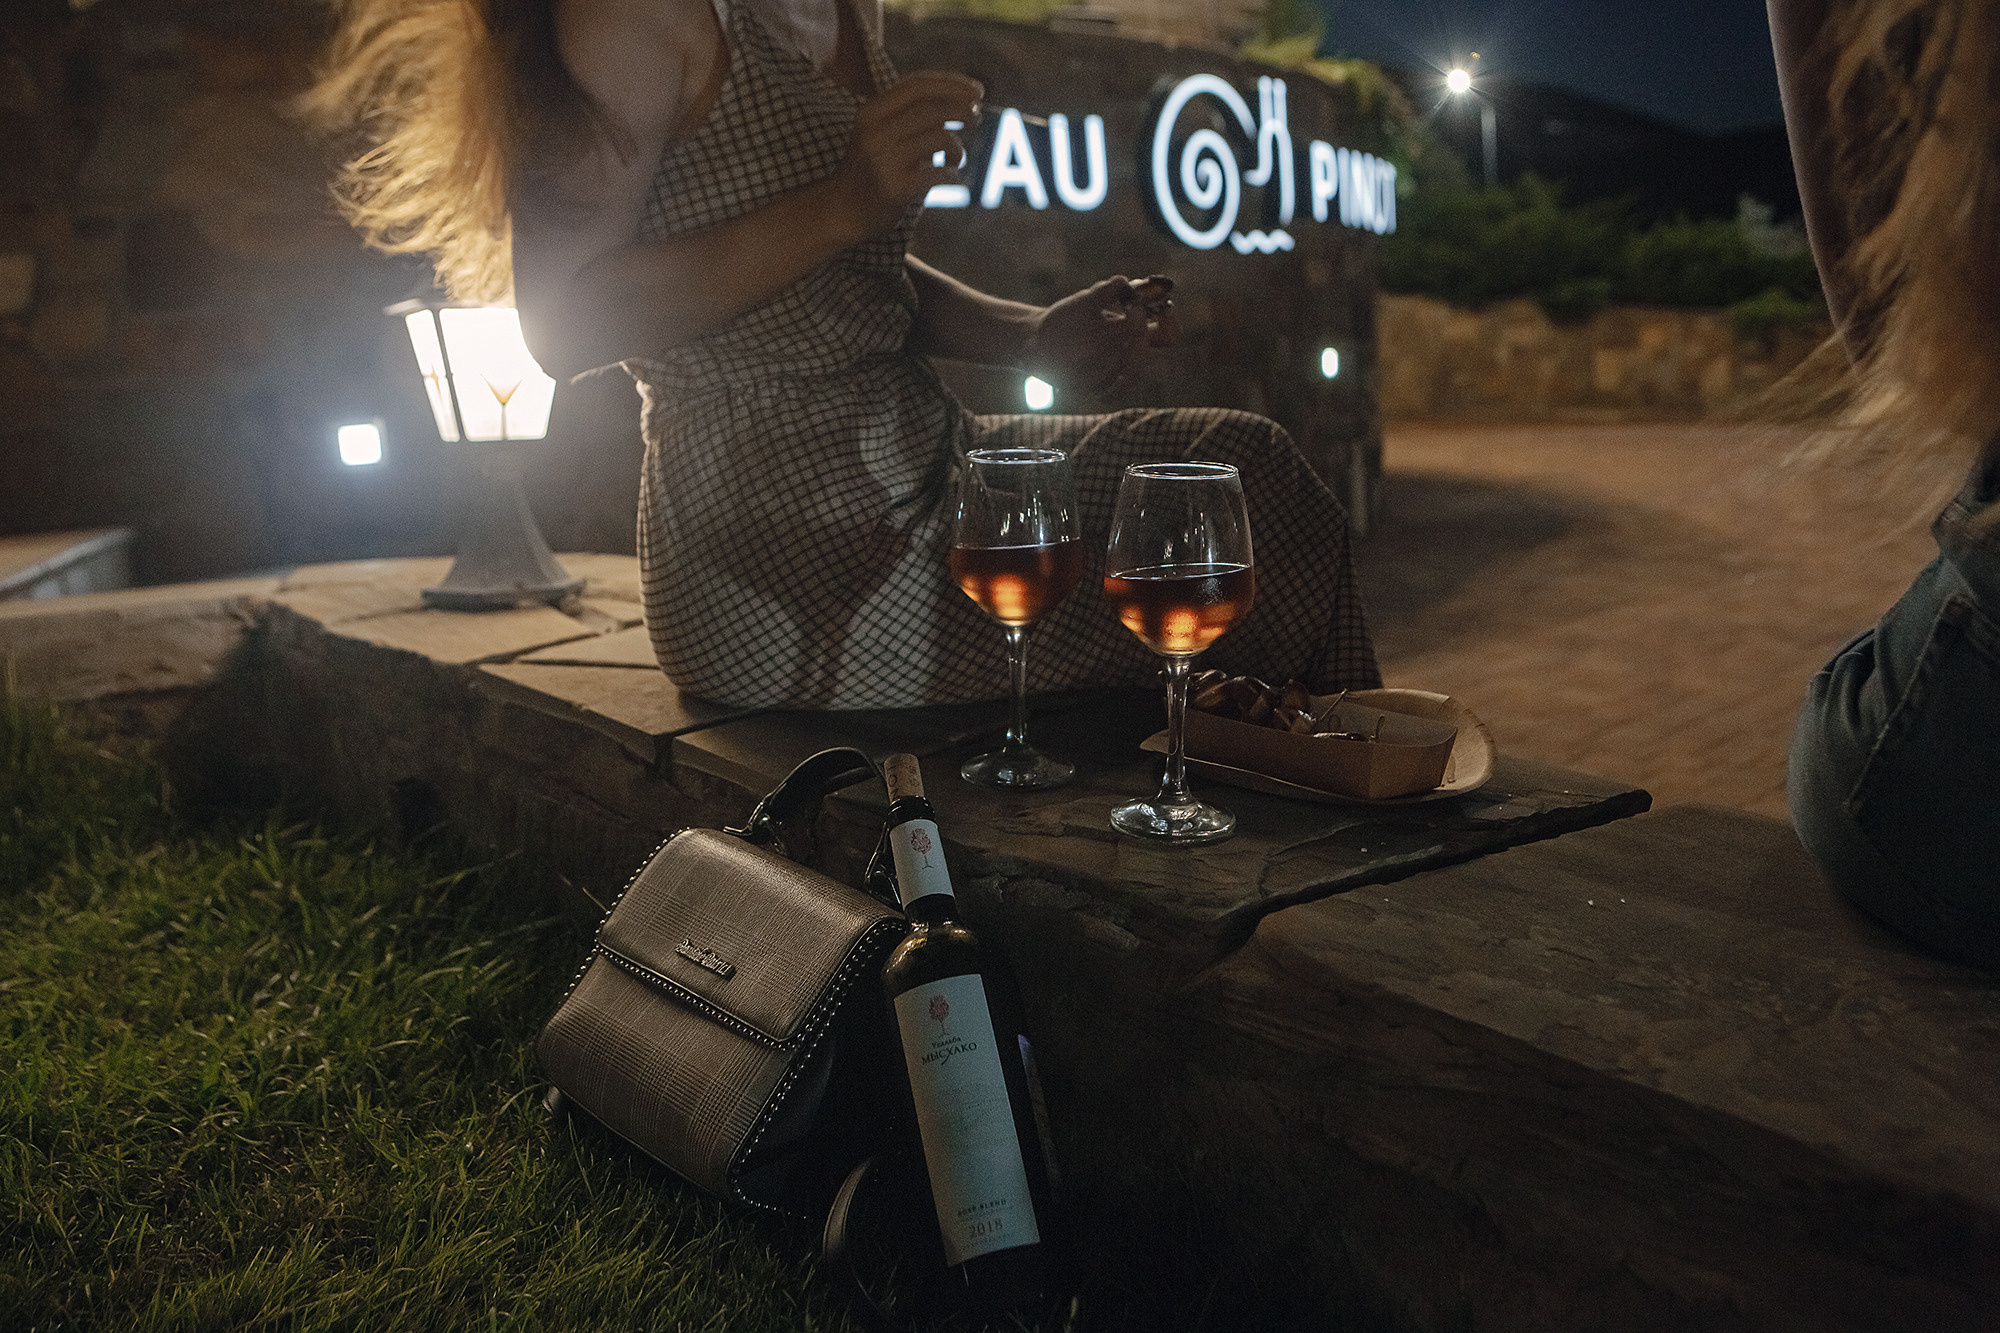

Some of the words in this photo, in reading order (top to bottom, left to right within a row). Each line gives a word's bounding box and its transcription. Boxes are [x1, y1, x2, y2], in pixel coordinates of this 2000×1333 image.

[1309, 139, 1397, 235] PINOT
[921, 1042, 977, 1066] МЫСХАКО
[968, 1219, 1003, 1239] 2018
